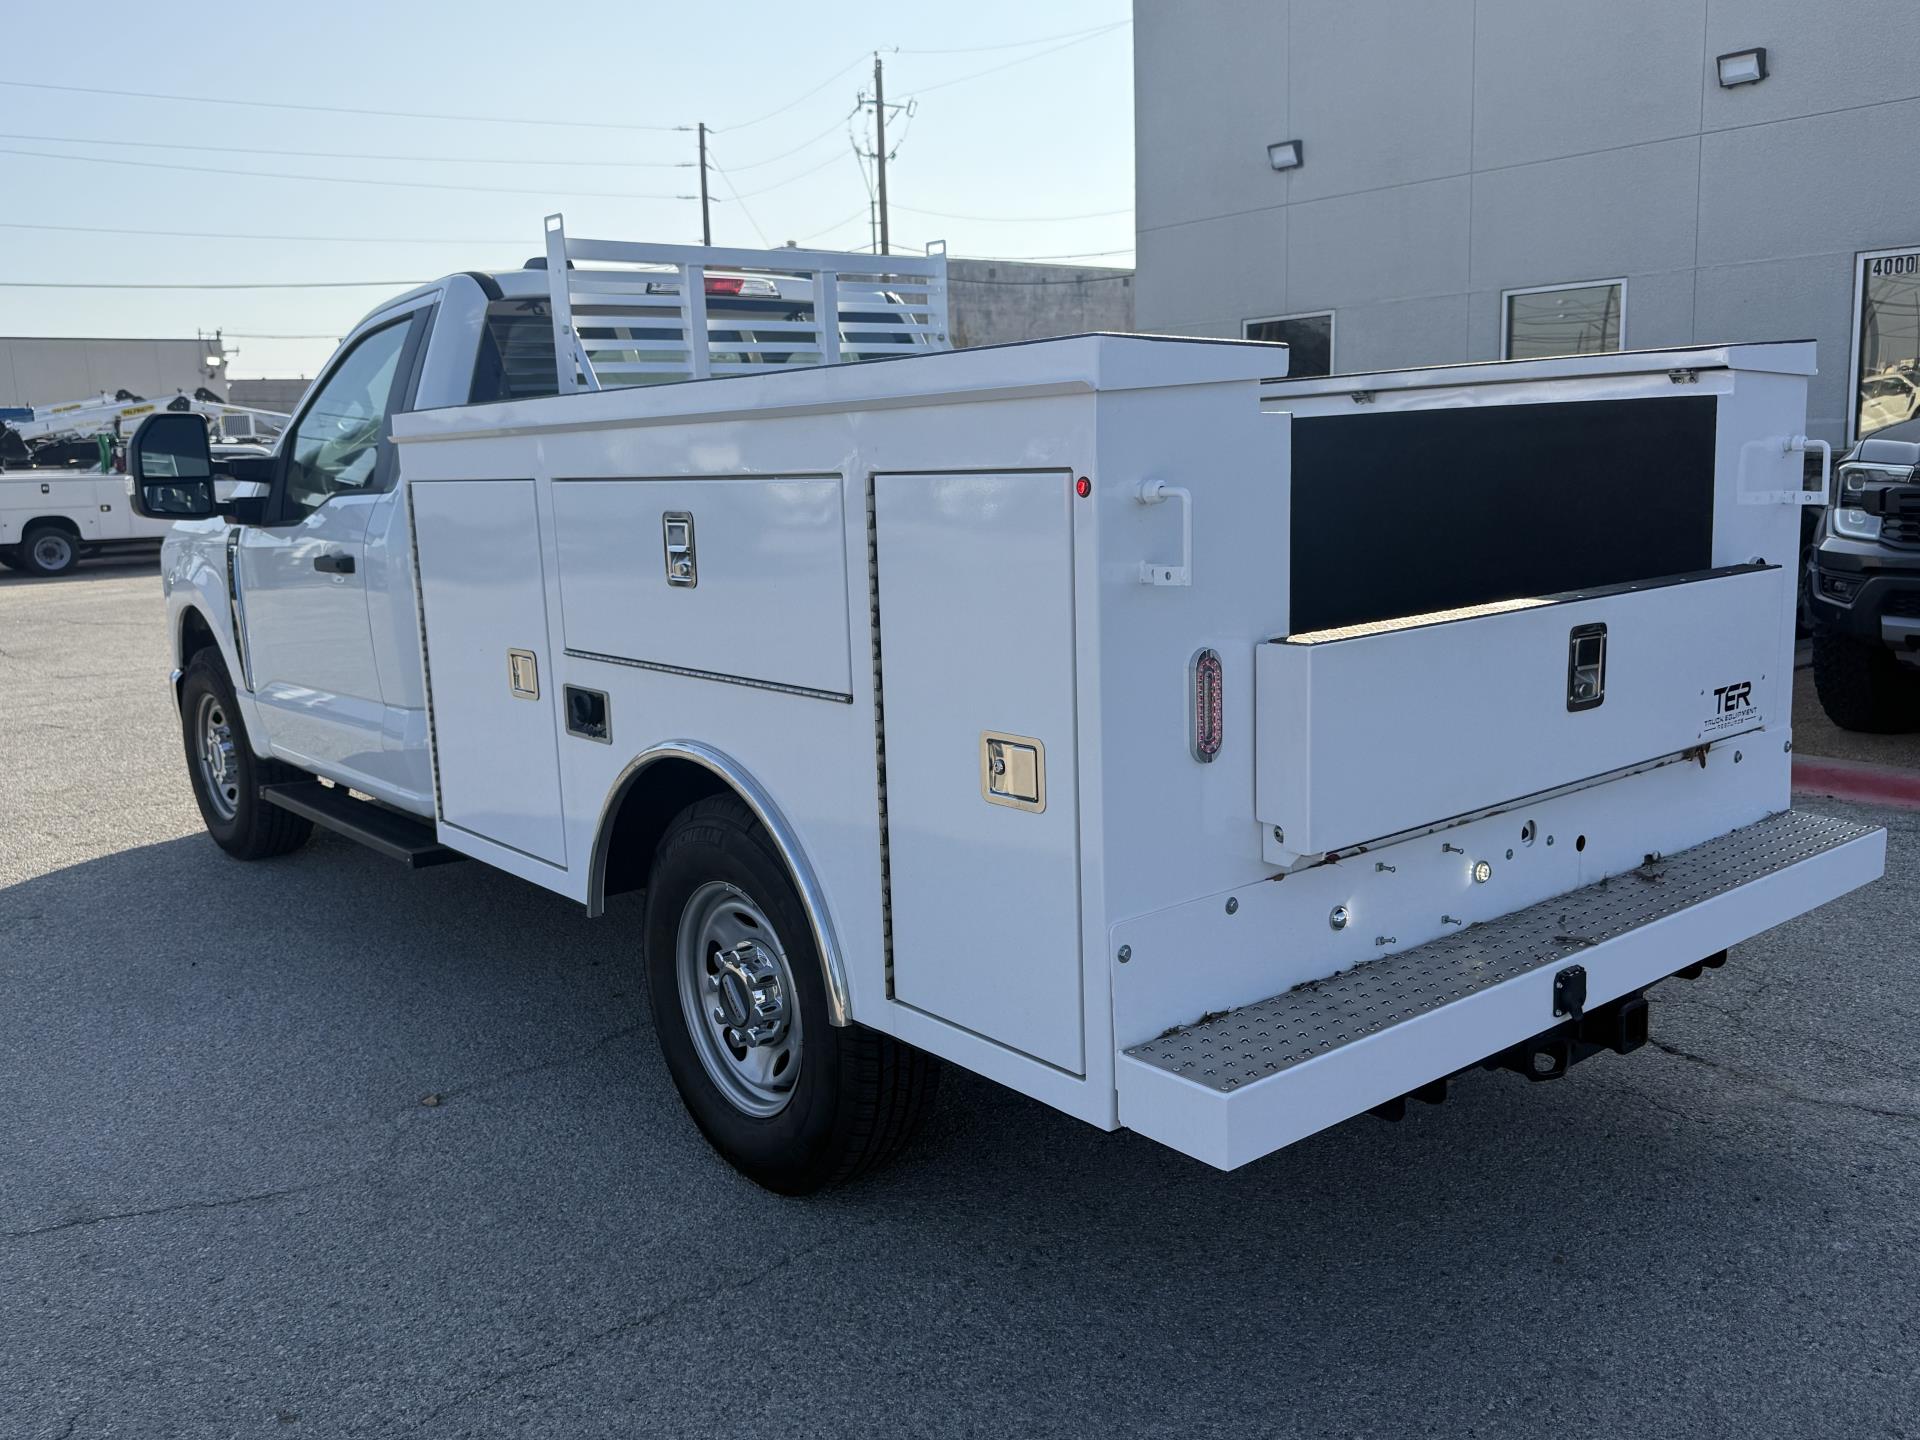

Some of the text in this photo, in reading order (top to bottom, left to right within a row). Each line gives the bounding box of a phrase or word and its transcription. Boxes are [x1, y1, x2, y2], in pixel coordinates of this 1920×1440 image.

[1713, 681, 1751, 714] TER
[1704, 707, 1757, 728] TRUCK EQUIPMENT
